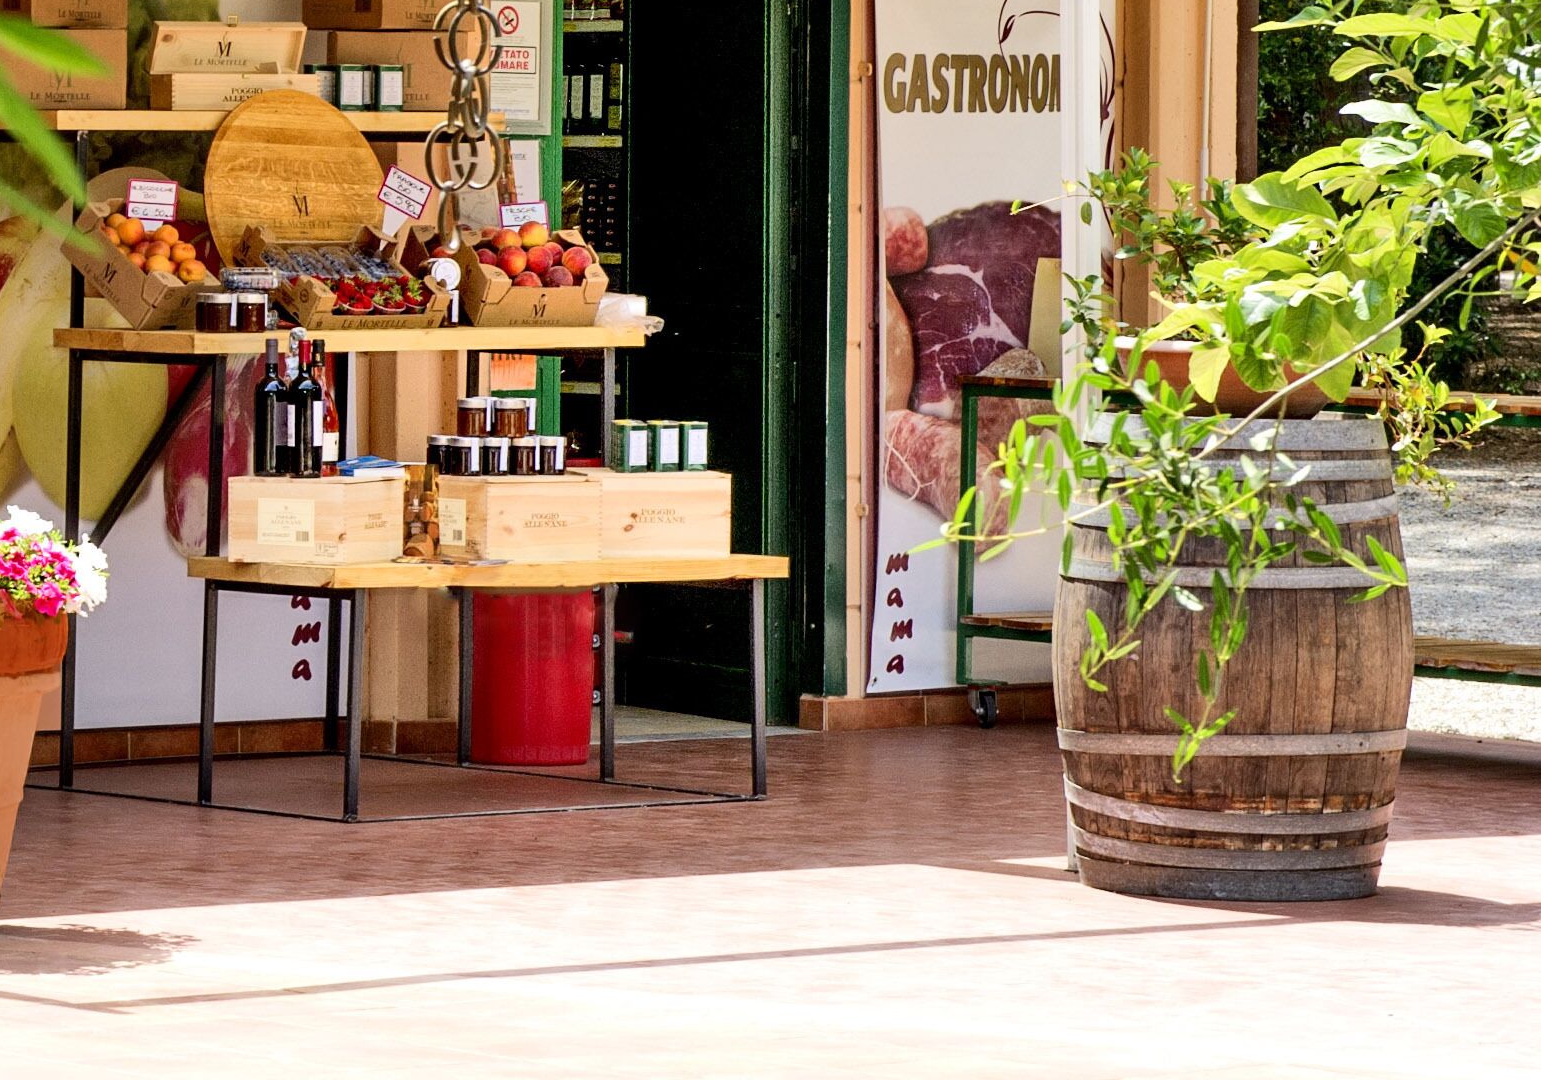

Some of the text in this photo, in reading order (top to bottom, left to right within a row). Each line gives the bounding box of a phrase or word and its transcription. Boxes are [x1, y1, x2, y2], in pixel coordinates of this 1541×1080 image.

[490, 50, 529, 59] TATO
[231, 87, 263, 95] POGGIO
[45, 92, 91, 101] MORTELLE
[356, 319, 407, 329] MORTELLE
[291, 595, 321, 681] ama
